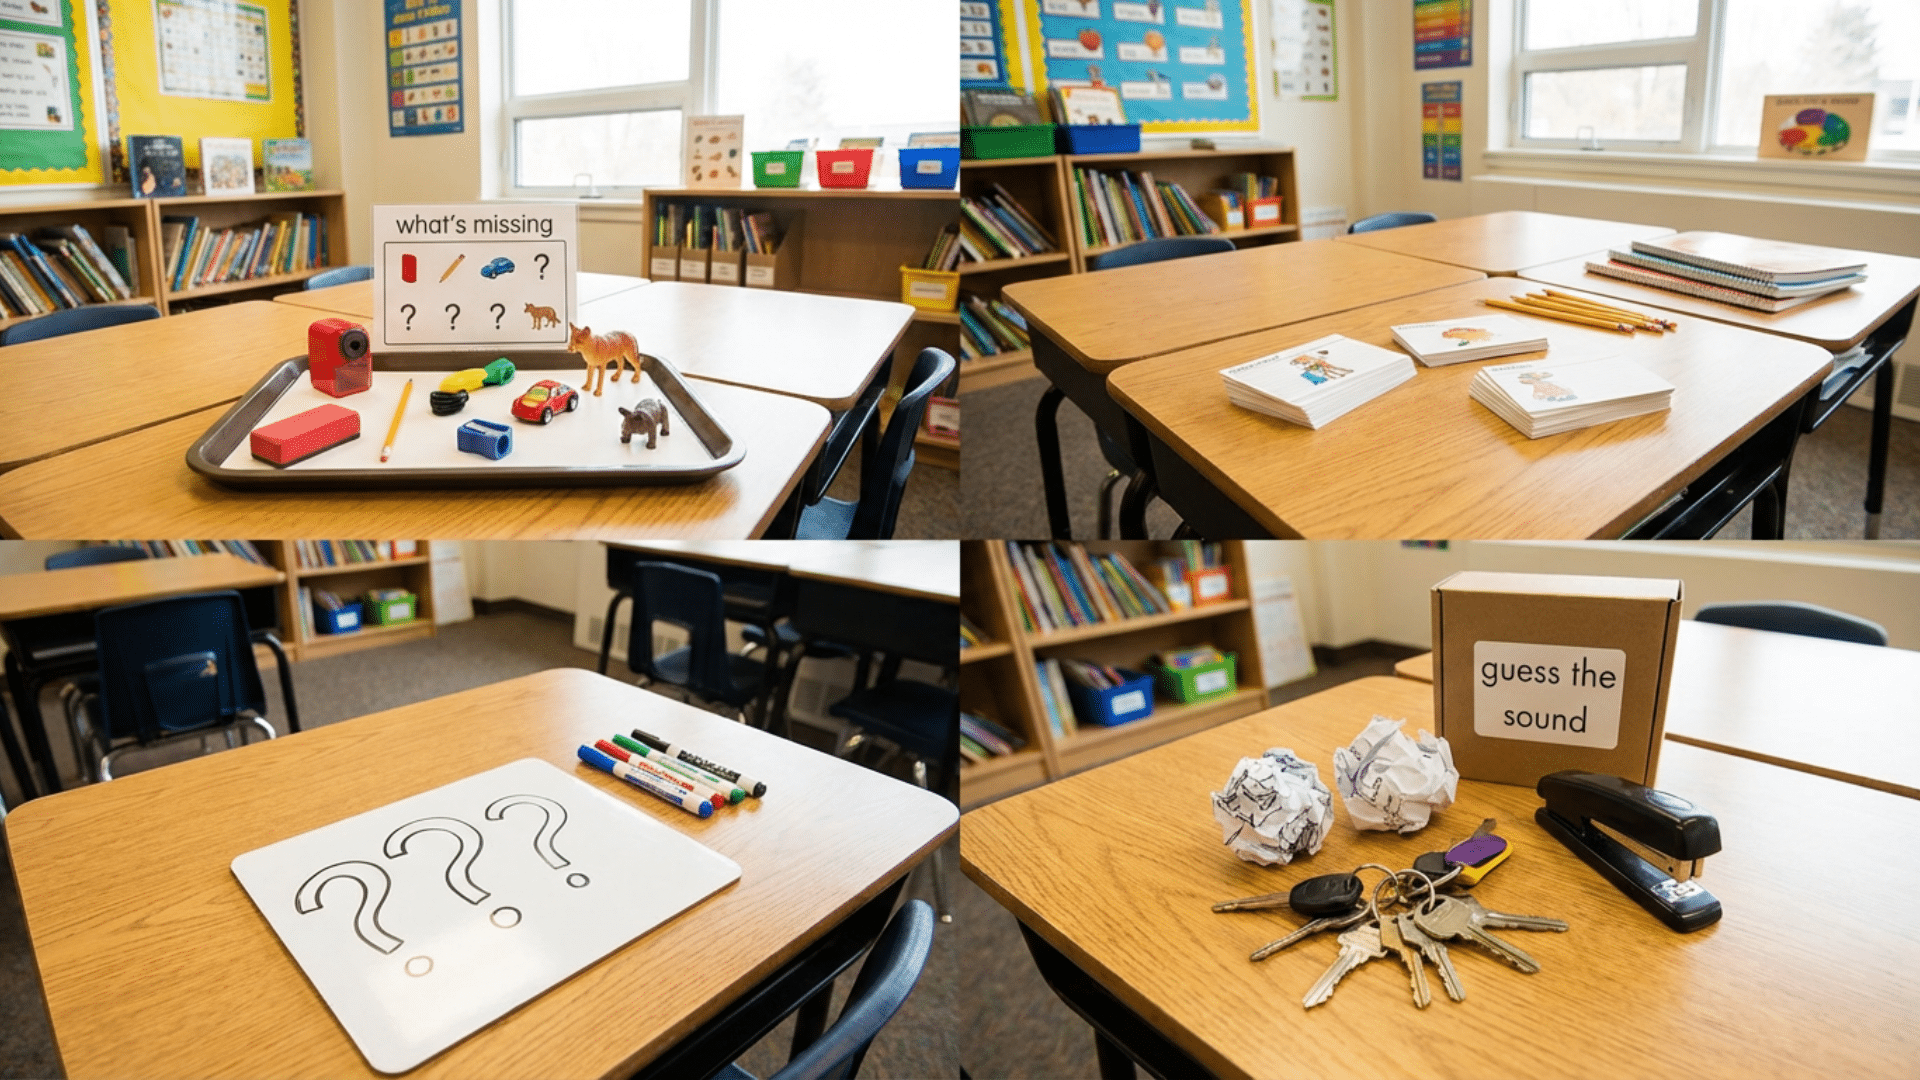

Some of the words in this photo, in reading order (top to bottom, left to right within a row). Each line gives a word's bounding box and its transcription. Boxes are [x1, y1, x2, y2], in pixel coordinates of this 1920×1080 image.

[396, 214, 466, 234] what's
[473, 215, 553, 238] missing
[534, 254, 549, 280] ?
[401, 304, 416, 331] ?
[445, 304, 460, 330] ?
[490, 303, 505, 329] ?
[1481, 662, 1560, 688] guess
[1572, 656, 1616, 689] the
[1503, 705, 1587, 733] sound
